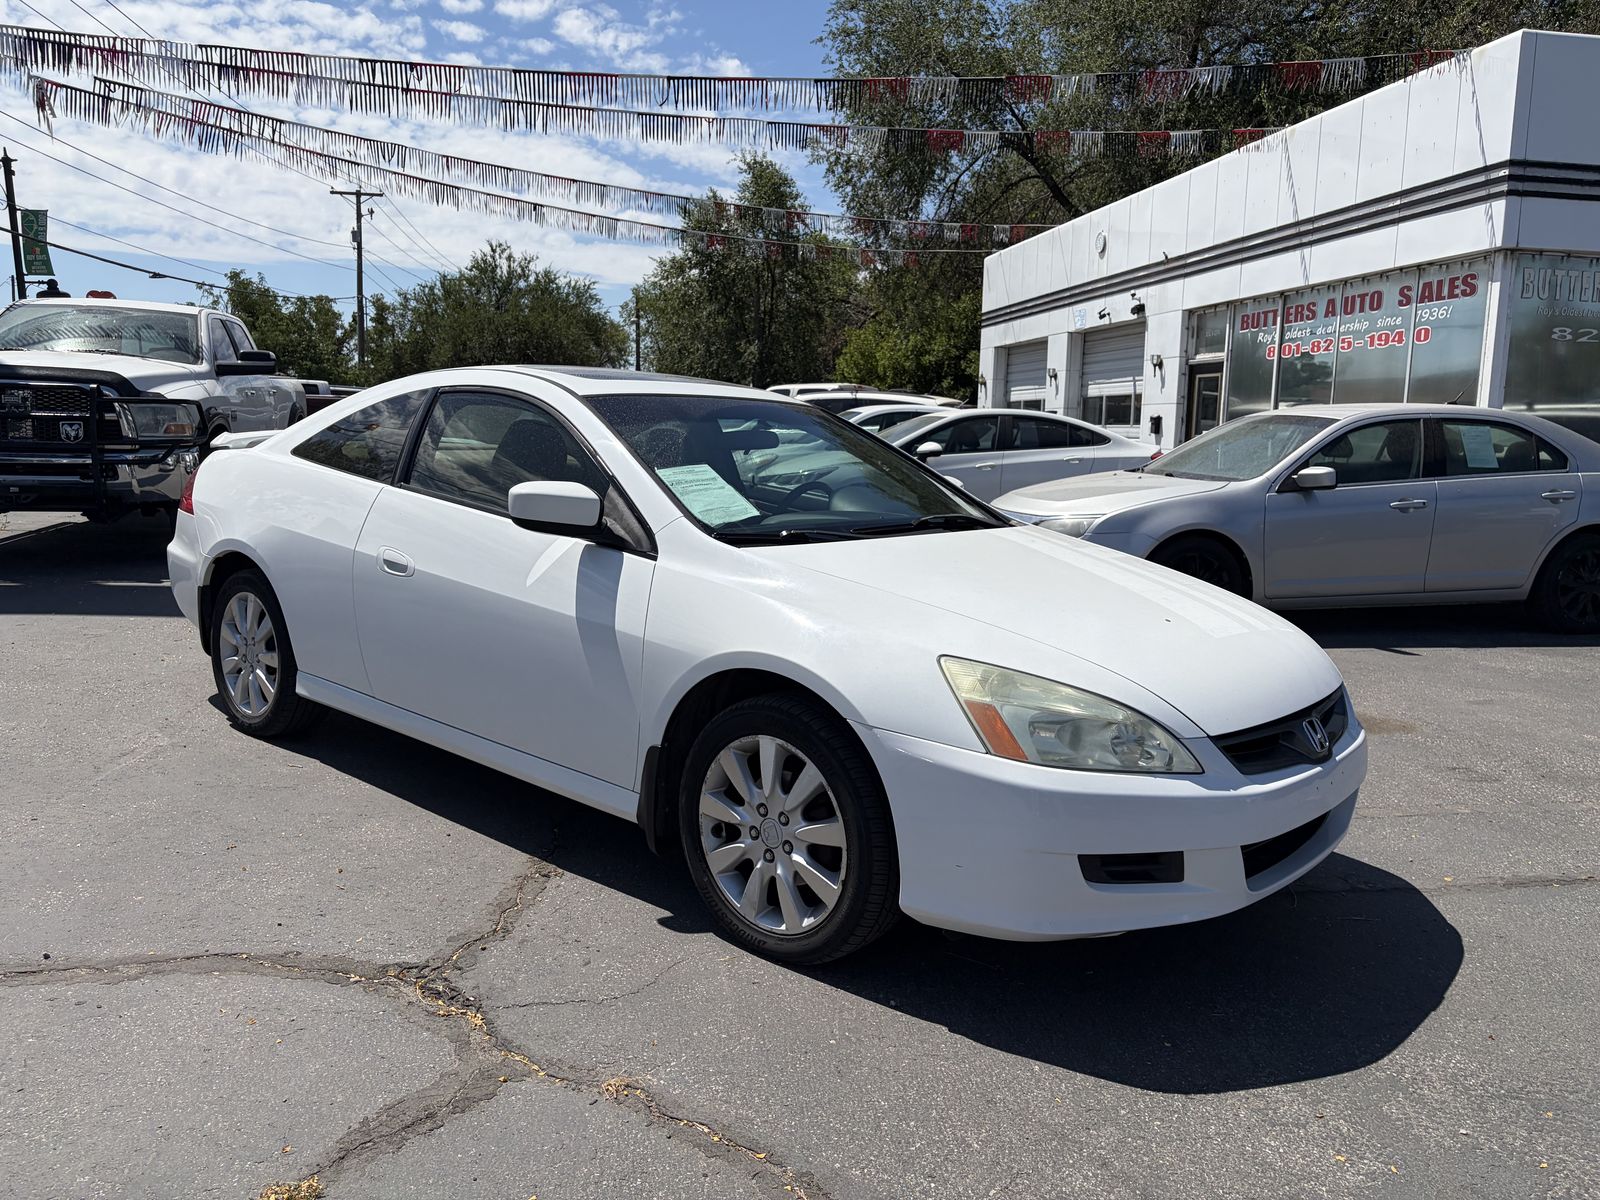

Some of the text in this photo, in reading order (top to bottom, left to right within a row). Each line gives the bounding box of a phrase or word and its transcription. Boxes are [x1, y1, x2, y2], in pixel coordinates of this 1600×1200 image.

[1323, 290, 1383, 319] AUTO
[1398, 273, 1478, 308] SALES
[1285, 327, 1311, 339] oldest
[1376, 316, 1402, 327] since
[1415, 305, 1453, 322] 1936!
[1552, 327, 1600, 343] 82
